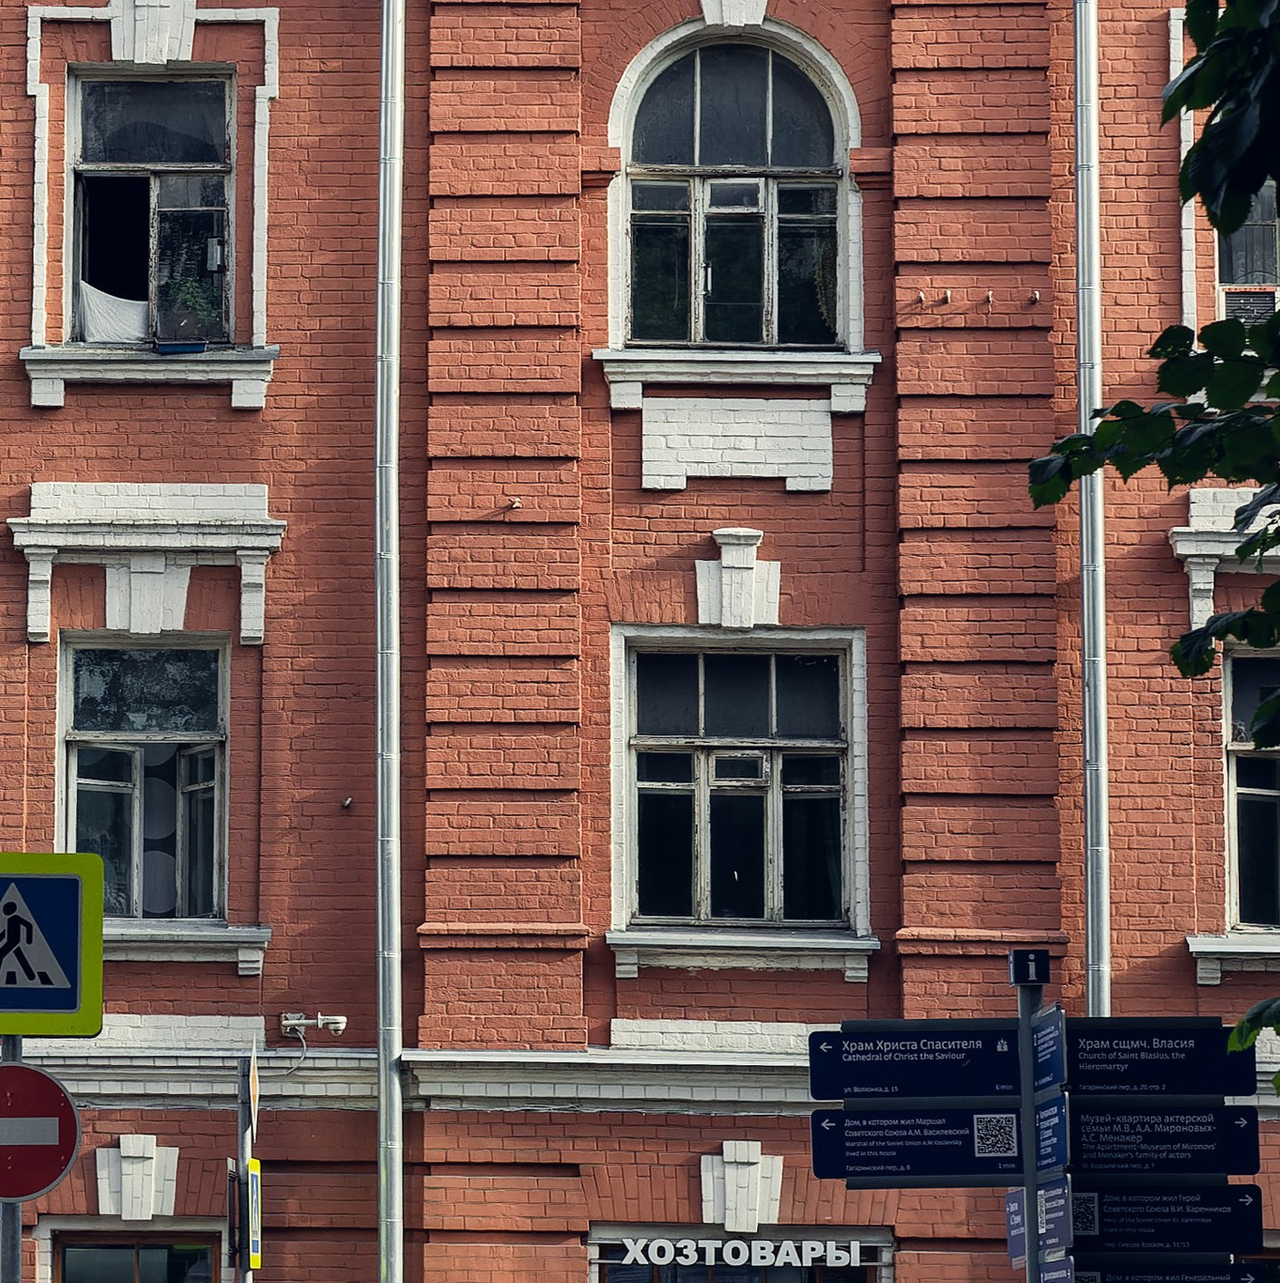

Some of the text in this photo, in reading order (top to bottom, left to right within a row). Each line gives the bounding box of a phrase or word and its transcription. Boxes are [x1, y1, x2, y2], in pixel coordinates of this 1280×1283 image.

[842, 1039, 982, 1053] Храм Христа Спасителя
[1078, 1038, 1195, 1051] Храм сщмч. Власия
[842, 1052, 966, 1061] Cathedral of Christ the Saviour
[1078, 1052, 1107, 1060] Church
[1108, 1052, 1117, 1060] of
[1118, 1052, 1138, 1060] Saint
[1172, 1052, 1186, 1060] the
[1079, 1062, 1129, 1072] Hieromartyr
[869, 1119, 897, 1127] котором
[1080, 1113, 1214, 1124] Музей-квартира актерской
[844, 1130, 883, 1138] Советского
[884, 1129, 907, 1138] Союза
[924, 1127, 970, 1136] Василевский
[1080, 1124, 1111, 1132] семьи
[1154, 1124, 1216, 1134] Мироновых-
[1100, 1134, 1144, 1144] Менакер
[1136, 1151, 1158, 1160] family
[622, 1238, 860, 1268] ХОЗТОВАРЫ
